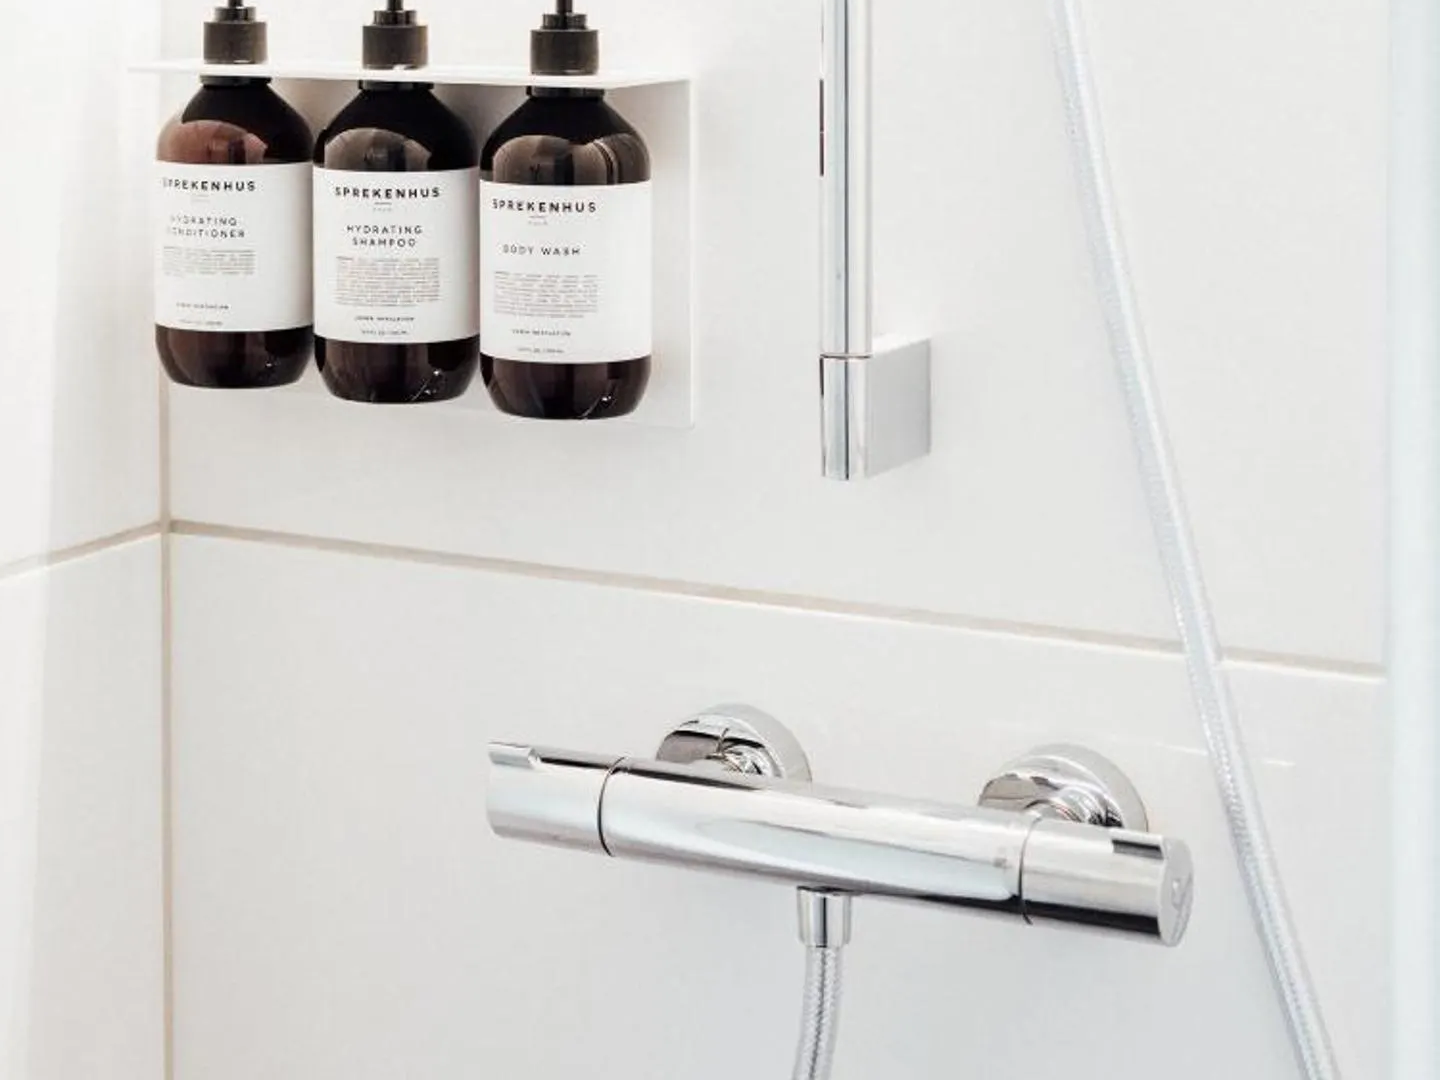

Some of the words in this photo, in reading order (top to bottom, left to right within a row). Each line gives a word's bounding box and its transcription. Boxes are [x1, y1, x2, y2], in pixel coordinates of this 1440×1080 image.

[335, 186, 440, 199] SPREKENHUS
[492, 198, 597, 213] SPREKENHUS
[346, 225, 423, 235] HYDRATING
[352, 237, 417, 248] SHAMPOO
[503, 244, 534, 255] BODY
[541, 247, 581, 256] WASH
